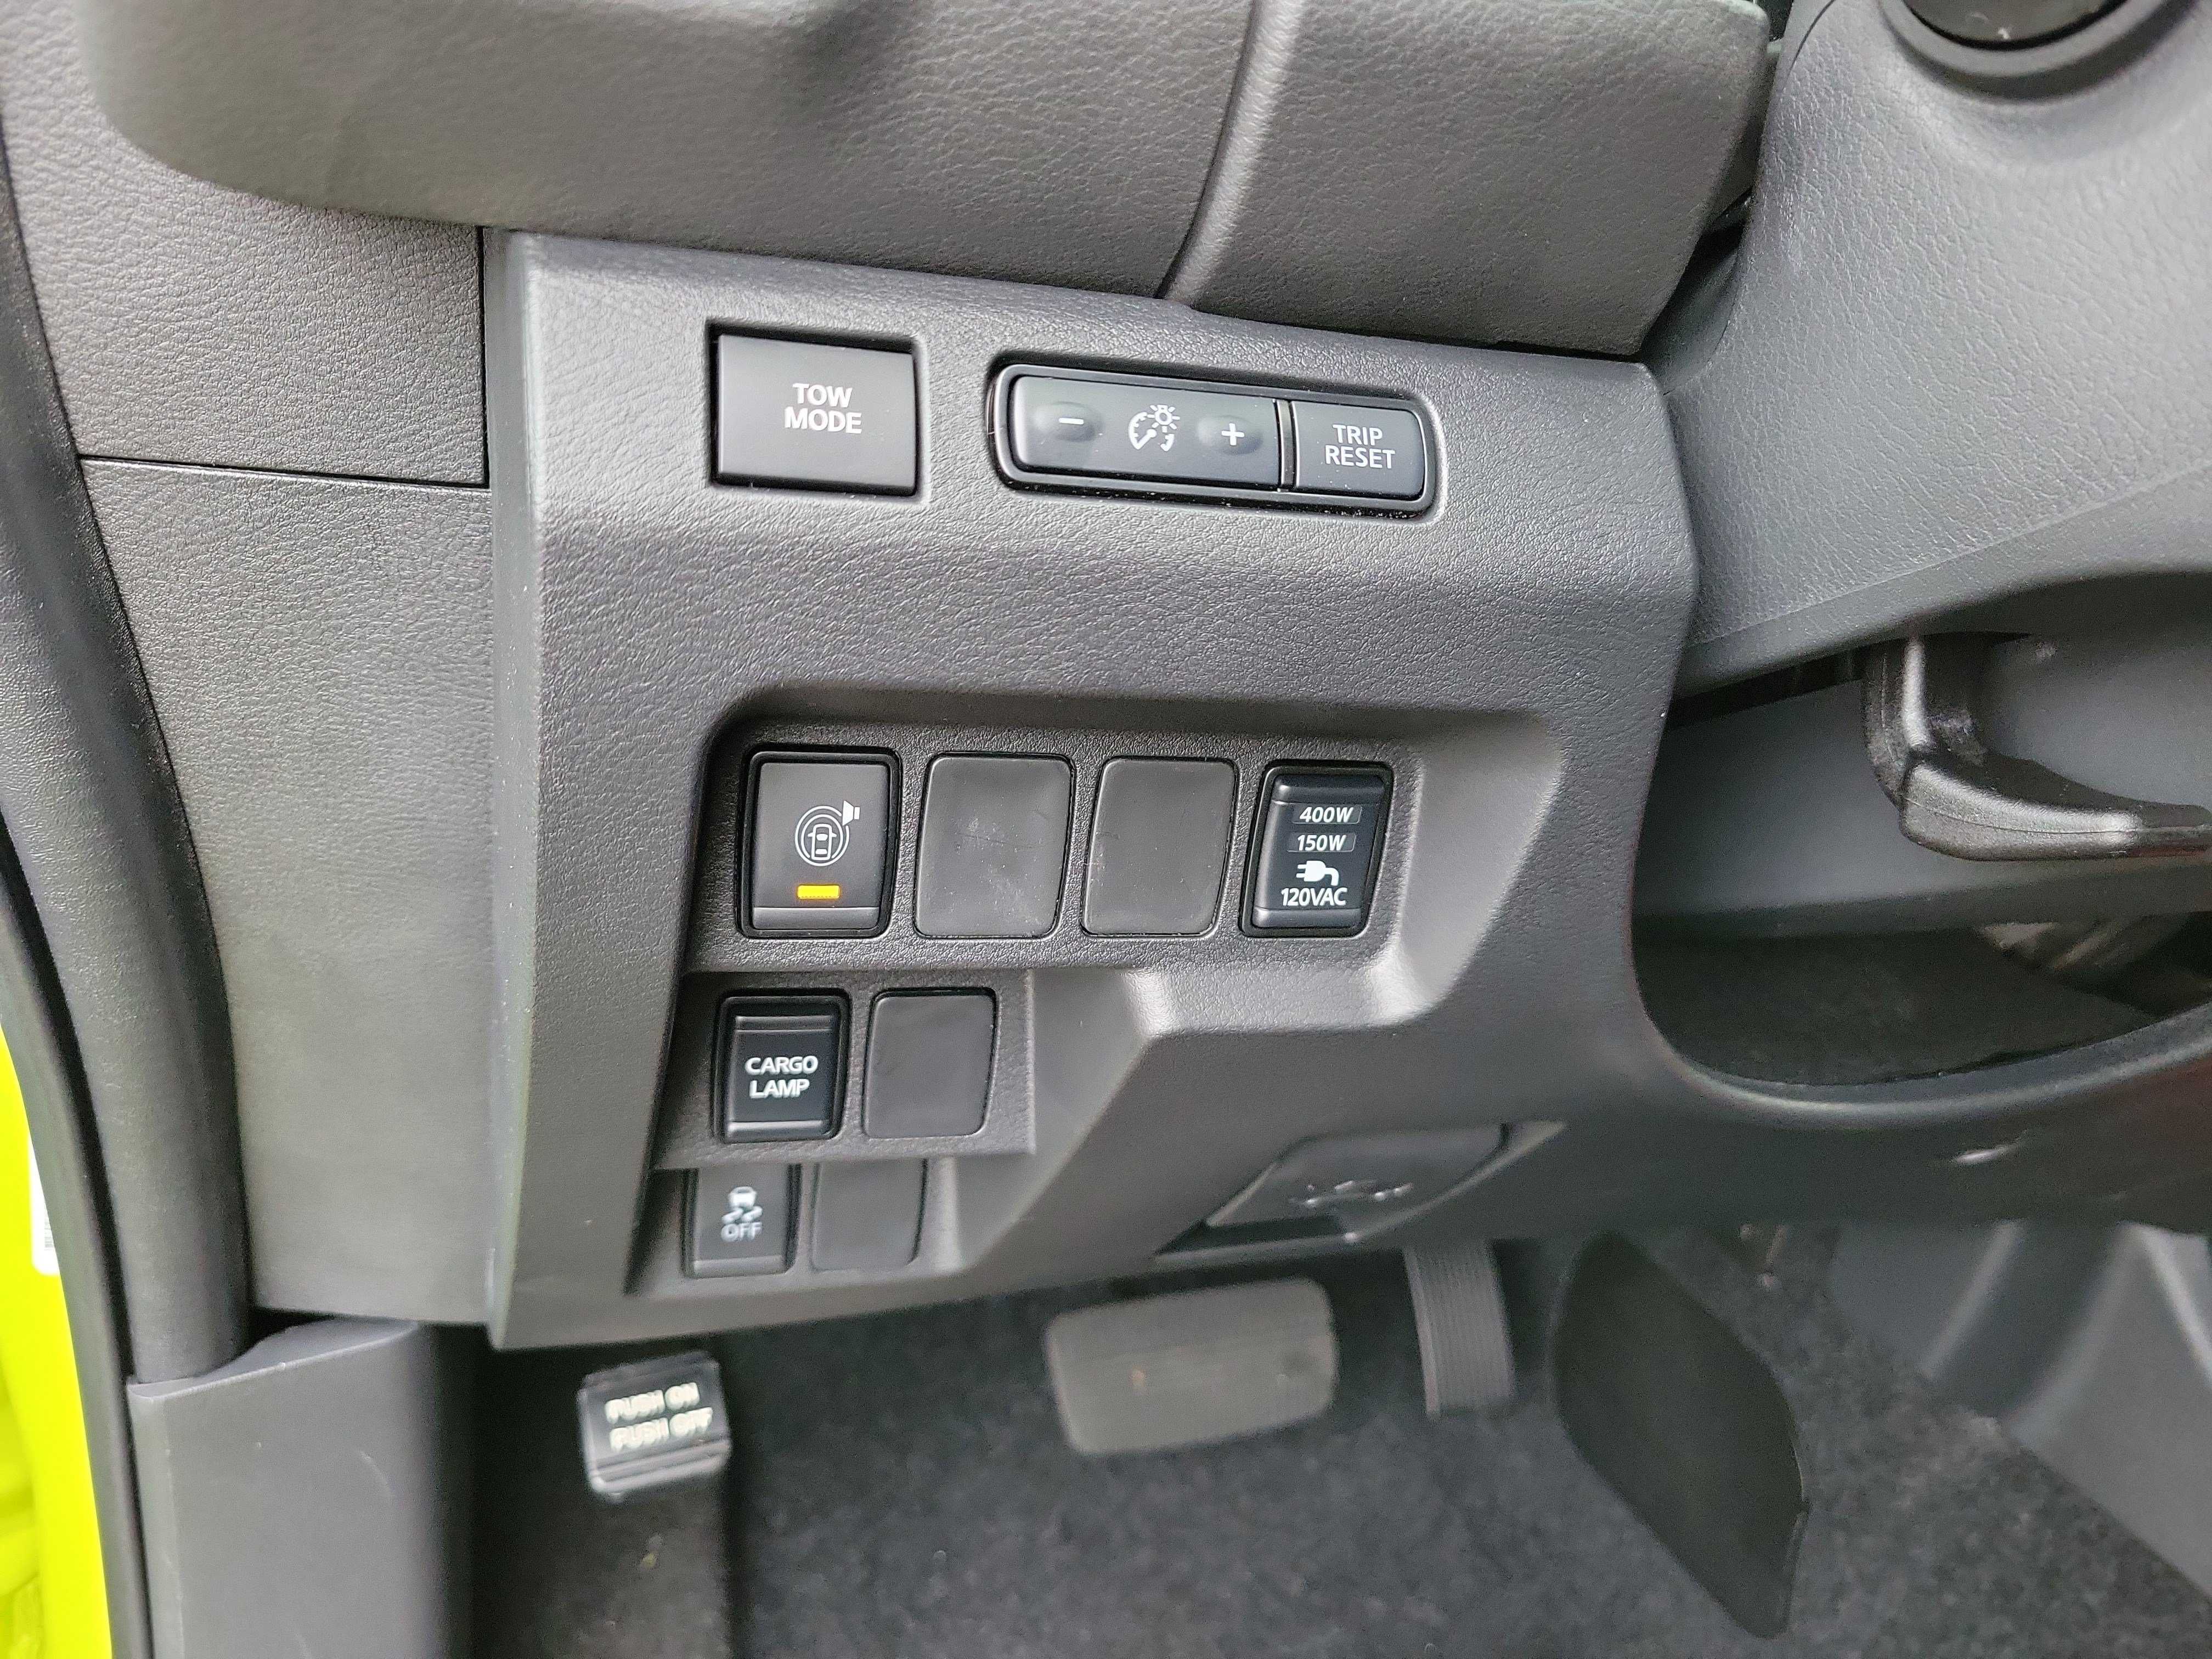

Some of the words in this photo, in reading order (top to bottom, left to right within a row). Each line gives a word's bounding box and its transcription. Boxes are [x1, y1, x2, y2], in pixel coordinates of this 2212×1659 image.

[792, 382, 853, 408] TOW
[784, 406, 863, 434] MODE
[1332, 424, 1384, 447] TRIP
[1325, 444, 1396, 470] RESET
[1299, 806, 1354, 823] 400W
[1297, 834, 1347, 851] 150W
[1280, 887, 1348, 906] 120VAC
[745, 1055, 819, 1075] CARGO
[749, 1079, 810, 1099] LAMP
[720, 1221, 763, 1242] OFF
[604, 1390, 665, 1424] PUSH
[609, 1418, 669, 1454] PUSH
[669, 1407, 713, 1438] OFF
